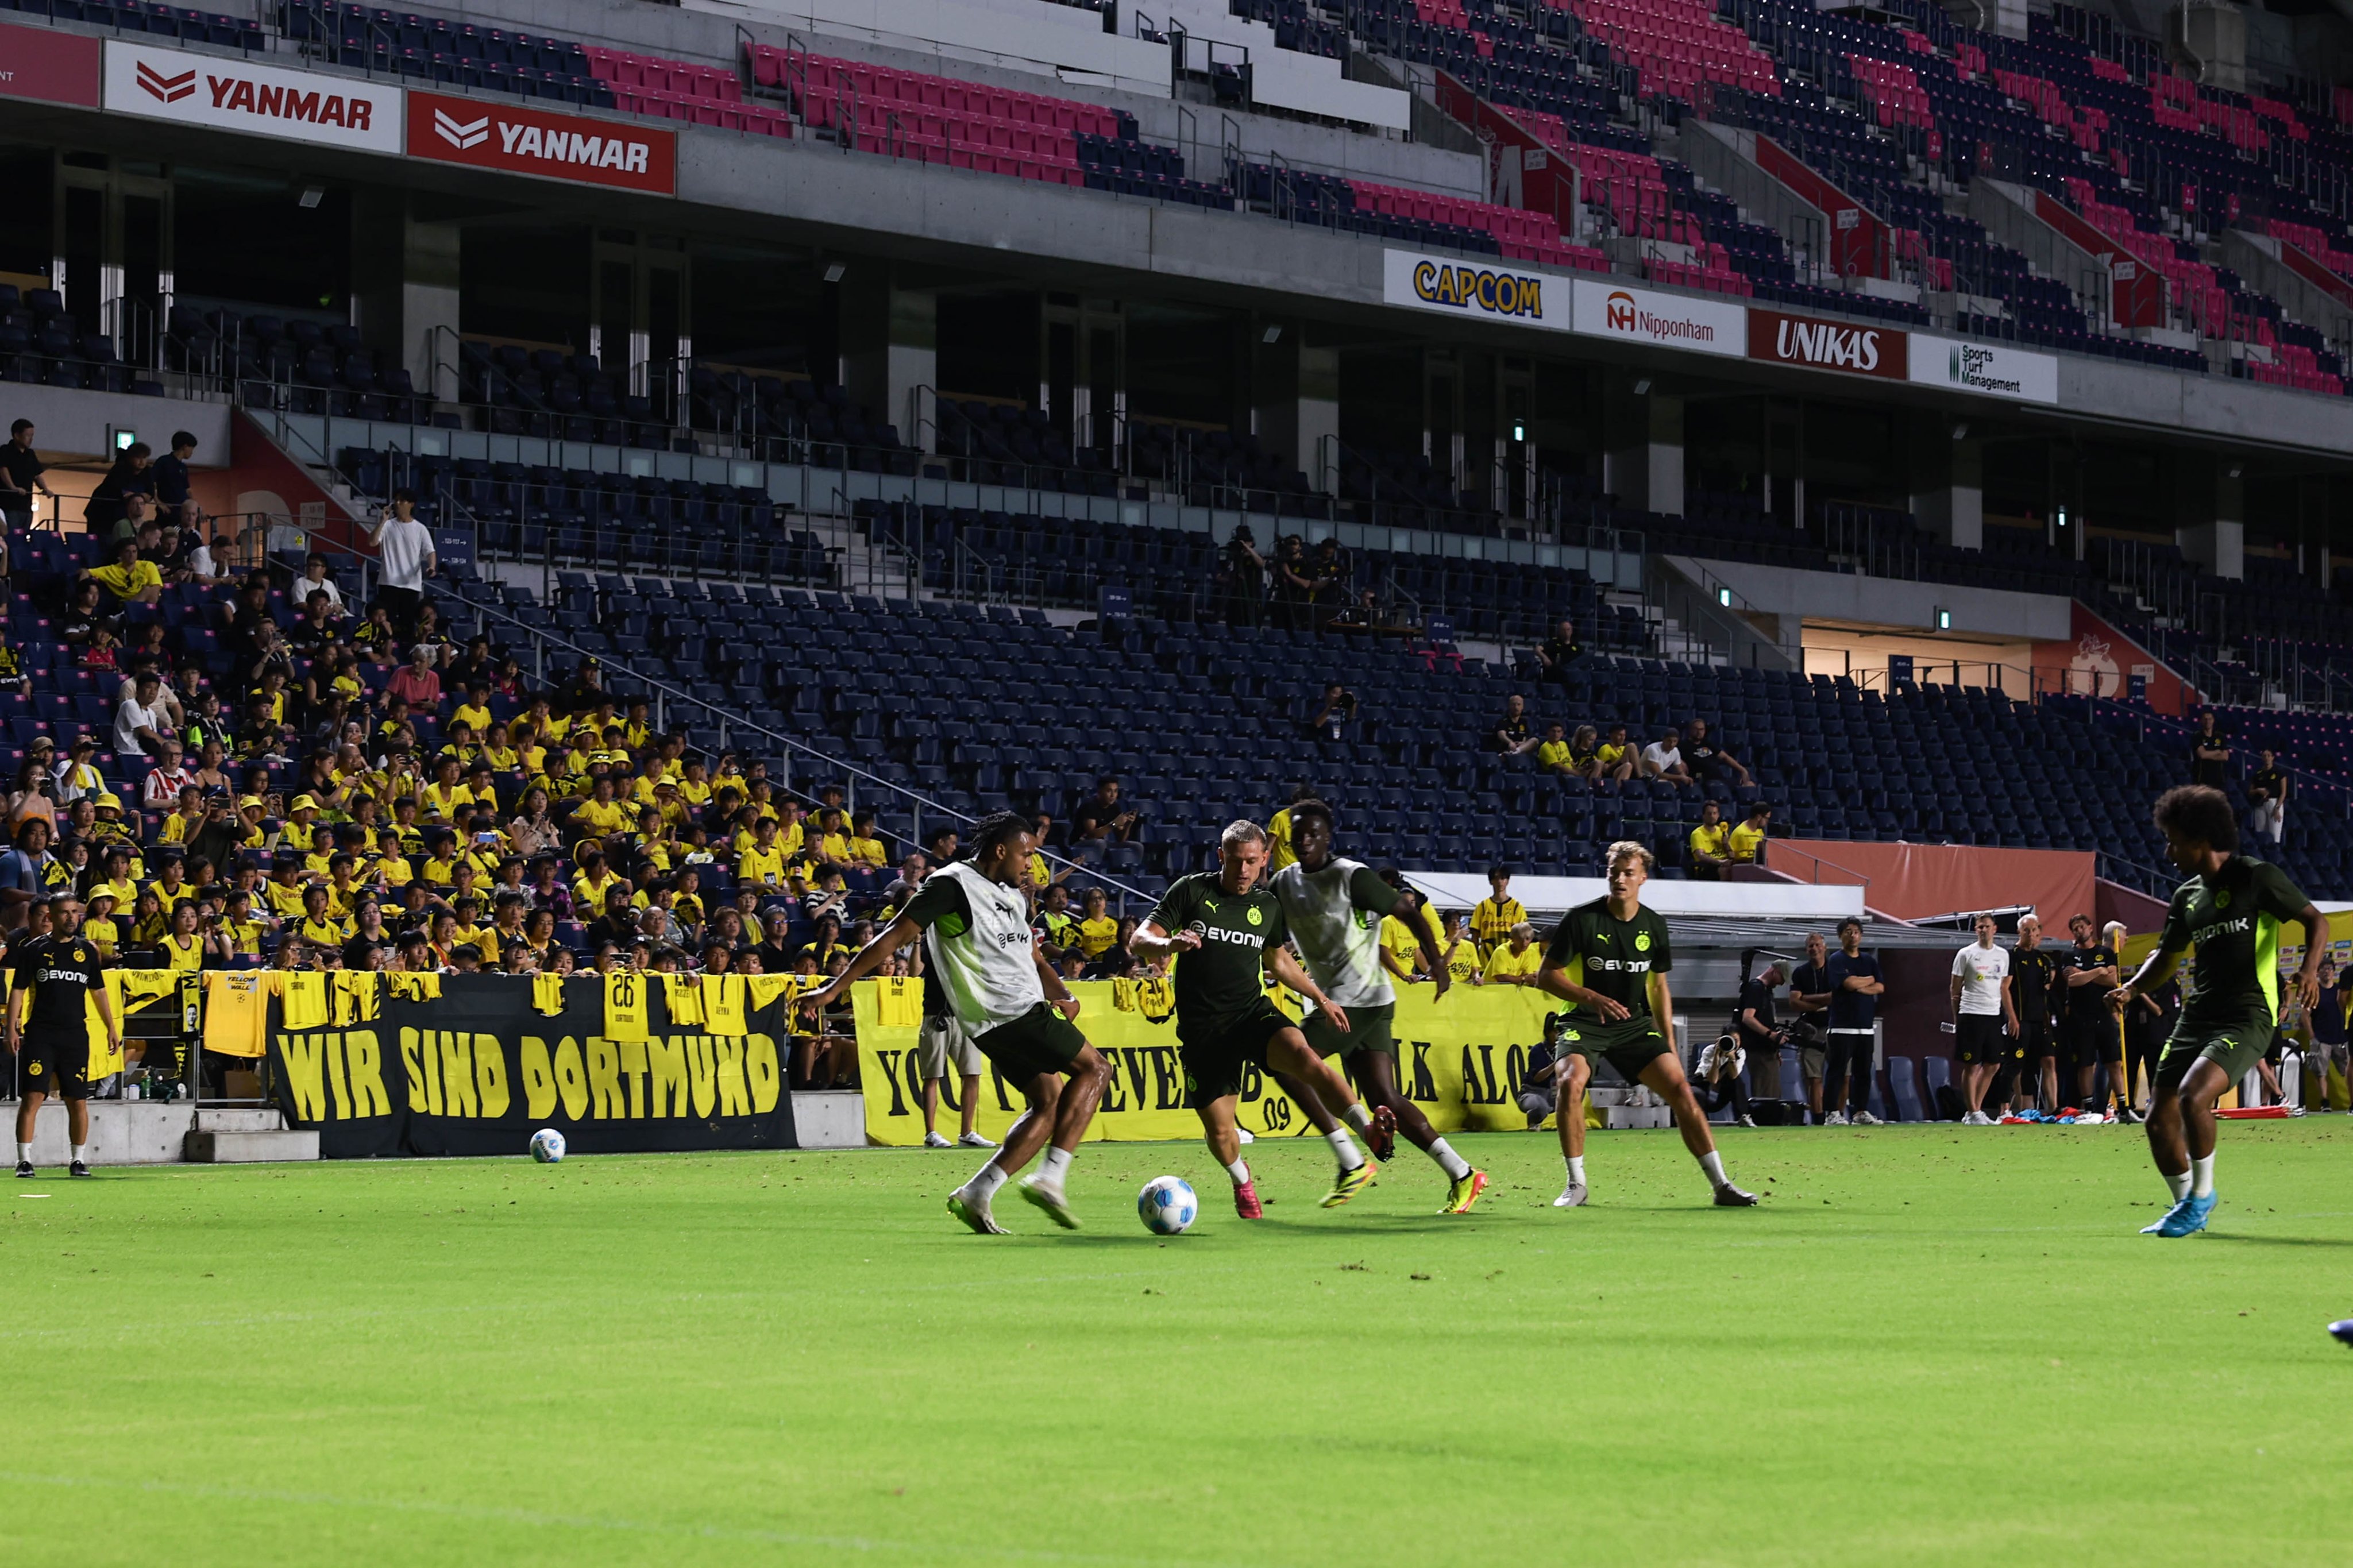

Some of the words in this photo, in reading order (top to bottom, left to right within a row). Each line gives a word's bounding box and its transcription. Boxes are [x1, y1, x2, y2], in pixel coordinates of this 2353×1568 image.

[207, 75, 372, 131] YANMAR
[497, 121, 649, 173] YANMAR
[1413, 260, 1542, 319] CAPCOM
[1640, 310, 1714, 342] Nipponham
[1776, 319, 1879, 371] UNIKAS
[1963, 345, 1993, 362] Sports
[1962, 358, 1983, 373] Turf
[1962, 372, 2020, 393] Management
[1208, 926, 1266, 949] EVONIK
[49, 970, 89, 984] EVONIK
[612, 974, 634, 1008] 26
[276, 1029, 392, 1122] WIR
[399, 1026, 510, 1118] SIND
[520, 1033, 780, 1122] DORTMUND
[1263, 1096, 1291, 1131] 09
